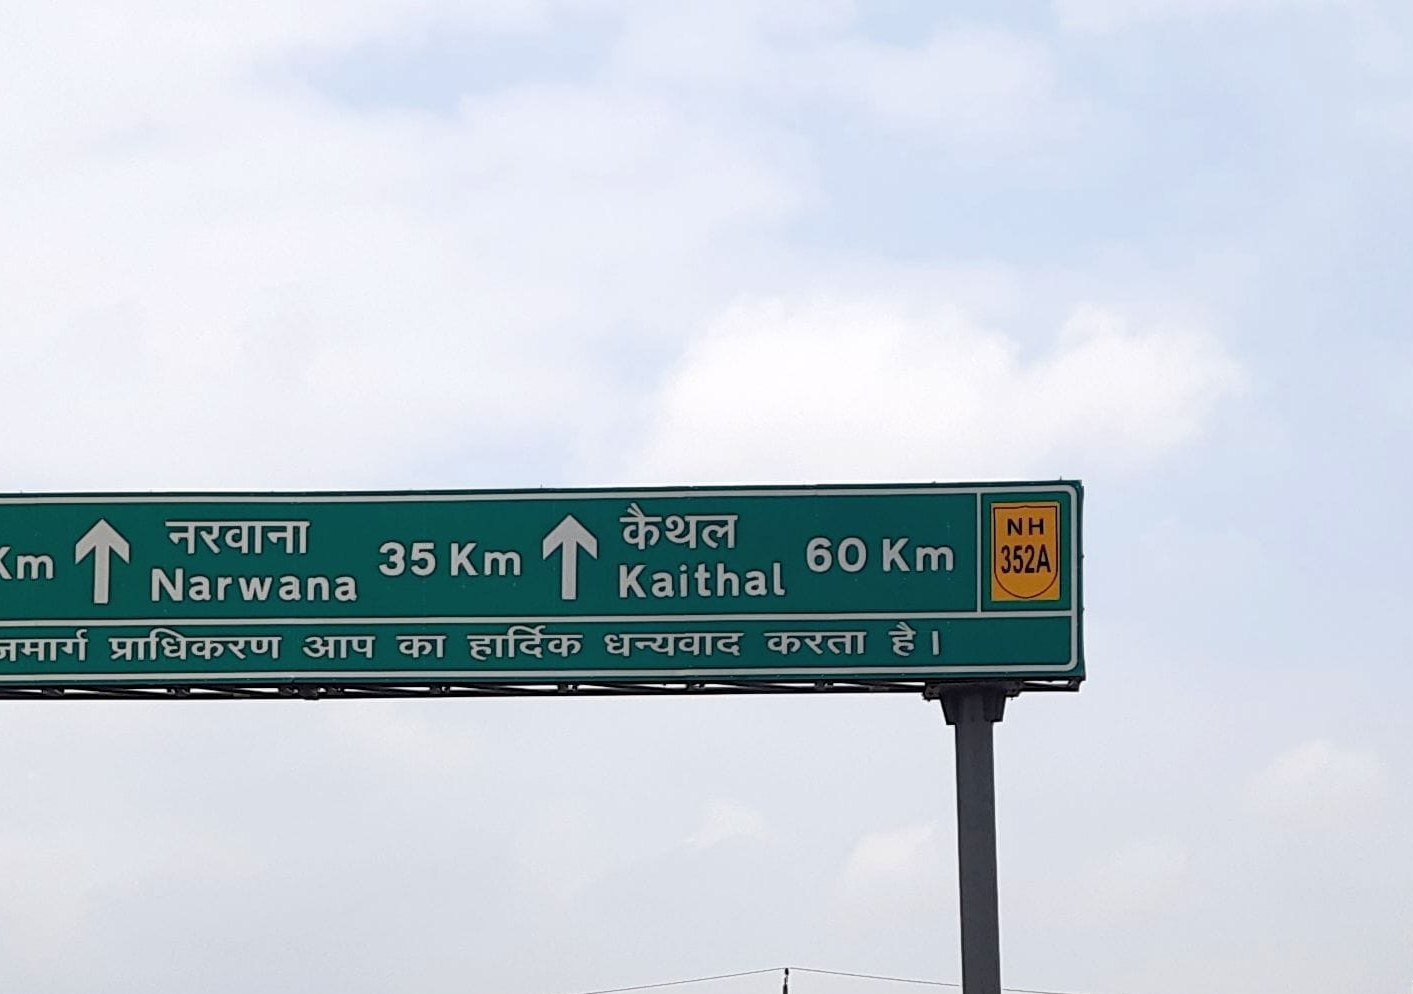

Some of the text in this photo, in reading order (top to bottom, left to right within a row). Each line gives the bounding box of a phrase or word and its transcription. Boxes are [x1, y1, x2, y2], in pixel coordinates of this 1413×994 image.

[166, 522, 311, 555] नरवाना
[621, 504, 739, 550] कैथल
[1007, 518, 1044, 536] NH
[380, 543, 522, 577] 35 Km
[808, 538, 954, 573] 60 Km
[1001, 544, 1051, 574] 352A
[152, 569, 358, 602] Narwana
[620, 564, 786, 599] Kaithal
[110, 629, 282, 661] प्राधिकरण
[302, 637, 376, 659] आप
[399, 636, 447, 659] का
[468, 626, 582, 661] हार्दिक
[605, 634, 741, 657] धन्यवाद
[764, 632, 866, 655] करता
